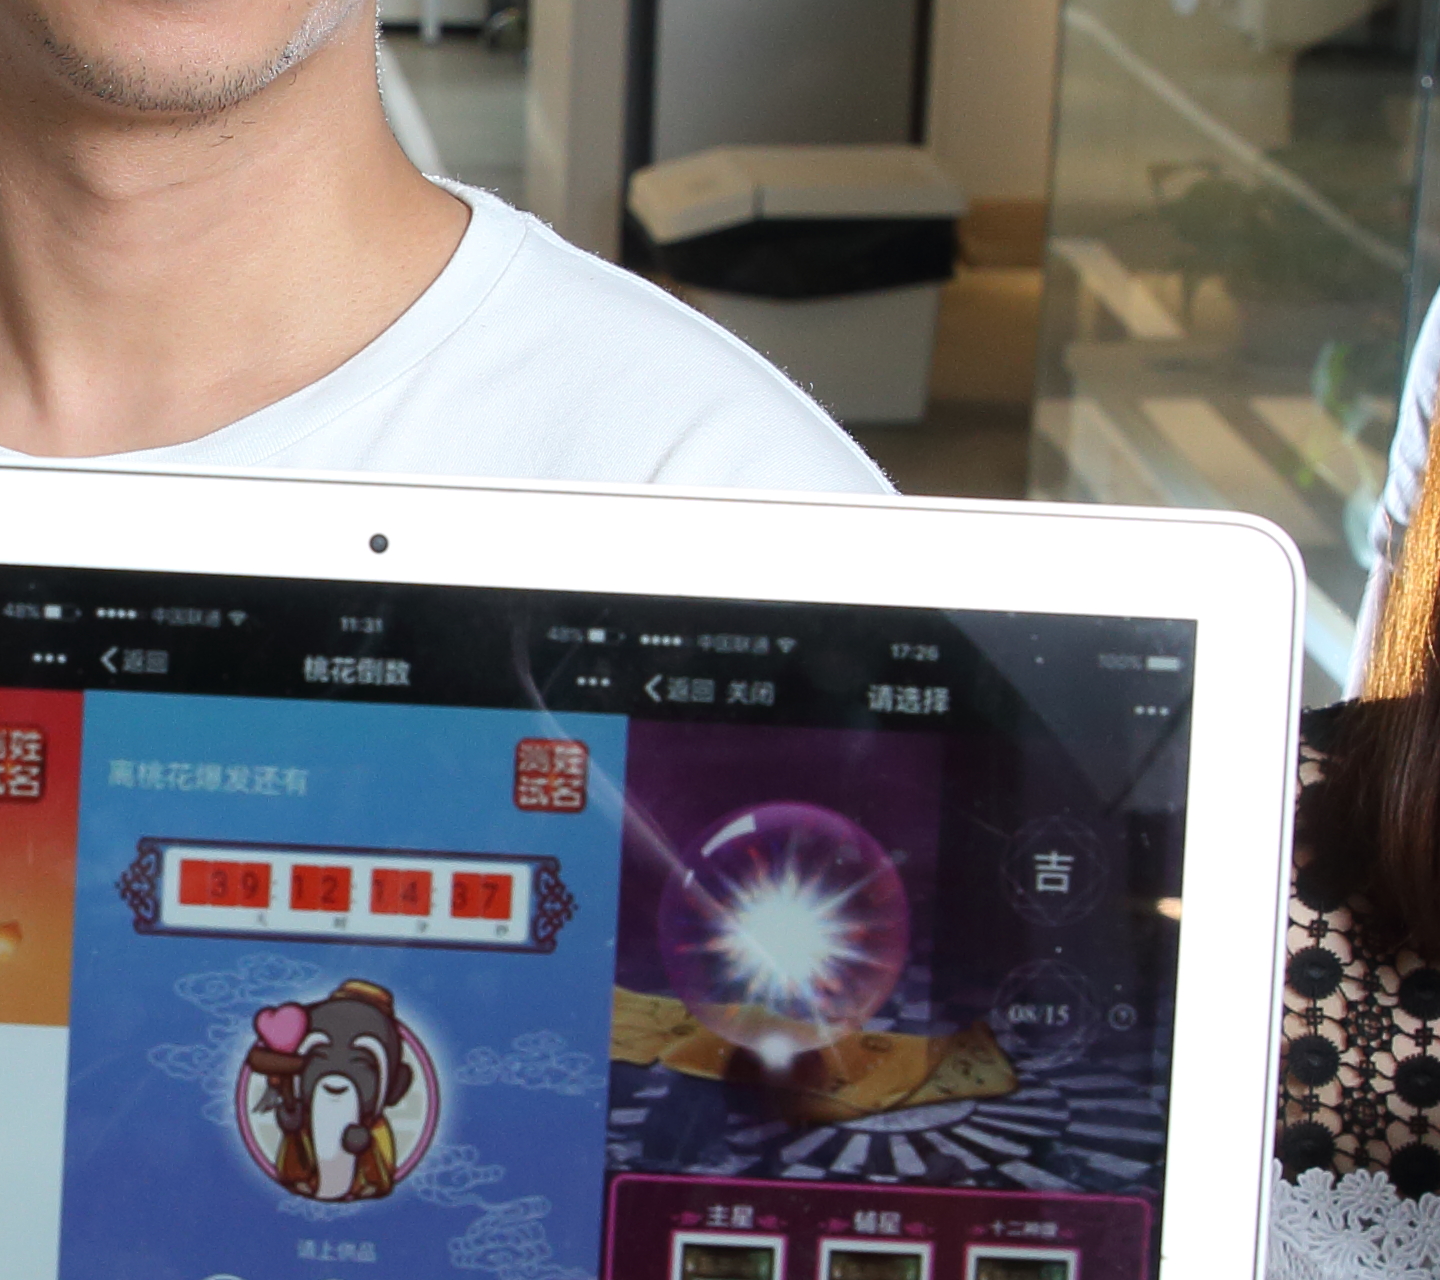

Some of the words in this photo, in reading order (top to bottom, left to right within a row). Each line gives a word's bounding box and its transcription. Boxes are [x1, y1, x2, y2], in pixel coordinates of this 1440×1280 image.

[303, 655, 411, 686] 桃花倒数
[667, 677, 715, 704] 返回
[726, 680, 776, 706] 关闭
[867, 685, 951, 715] 请选择
[1034, 850, 1074, 895] 吉
[1007, 1003, 1070, 1026] 08/15
[706, 1205, 754, 1228] 主星
